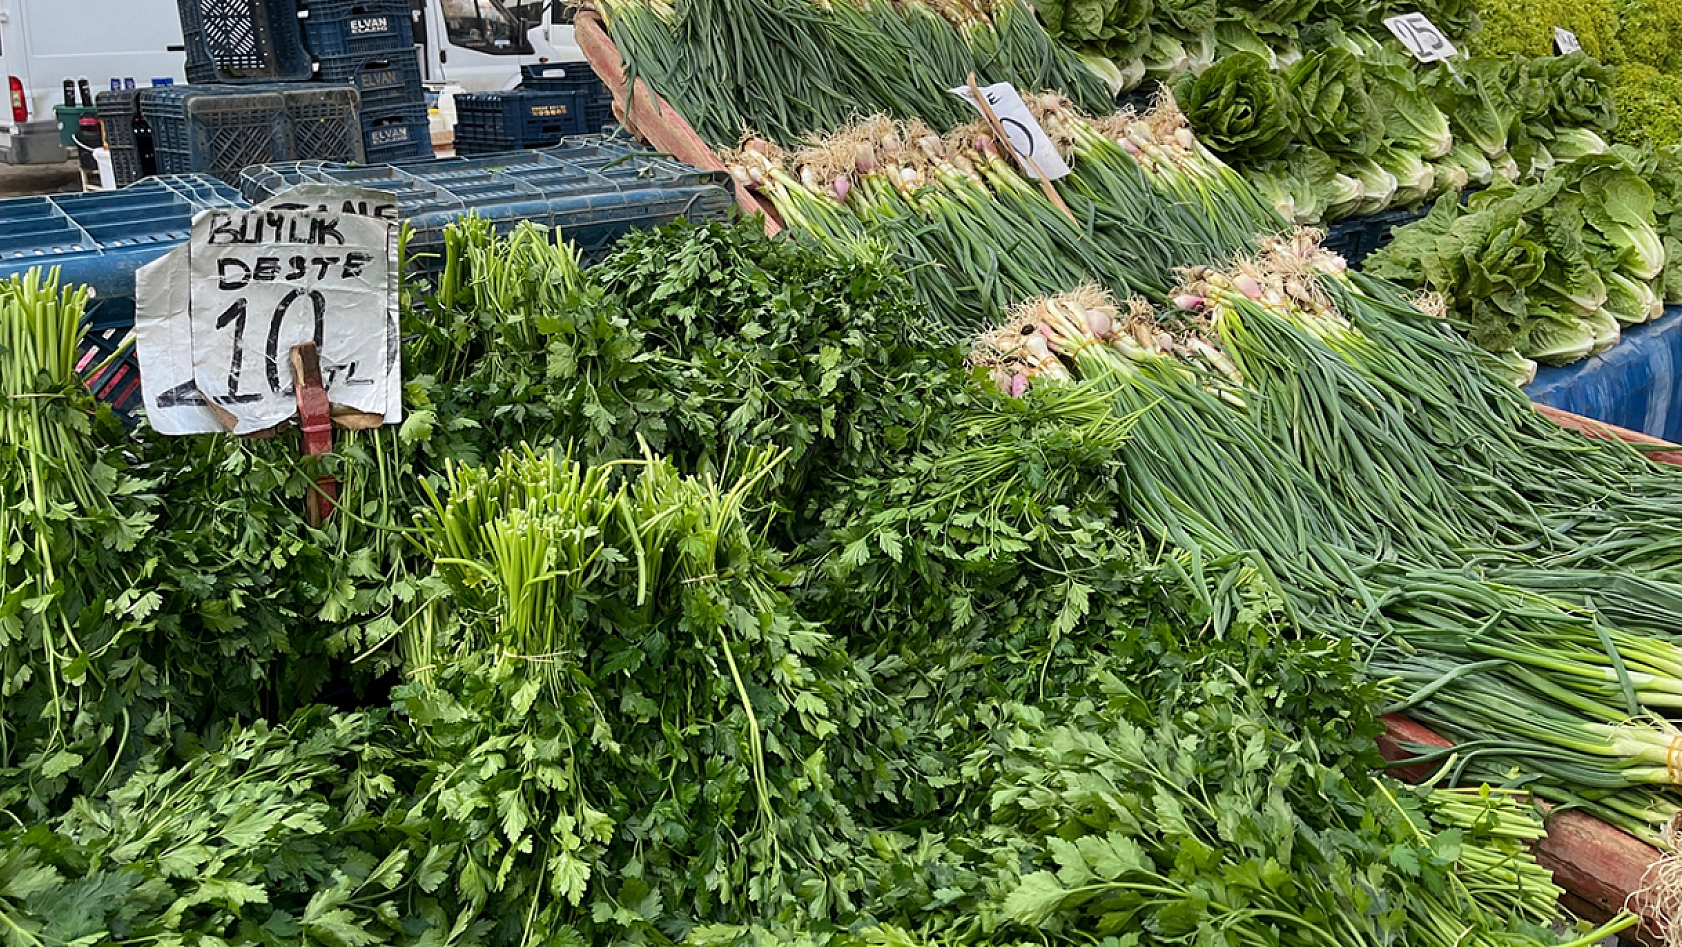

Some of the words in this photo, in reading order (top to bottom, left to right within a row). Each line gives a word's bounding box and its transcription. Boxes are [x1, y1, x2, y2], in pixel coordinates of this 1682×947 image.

[351, 18, 388, 29] ELVAN
[361, 71, 396, 87] ELVAN
[372, 127, 407, 141] ELVAN
[217, 252, 374, 290] DESTE
[213, 287, 326, 405] 10
